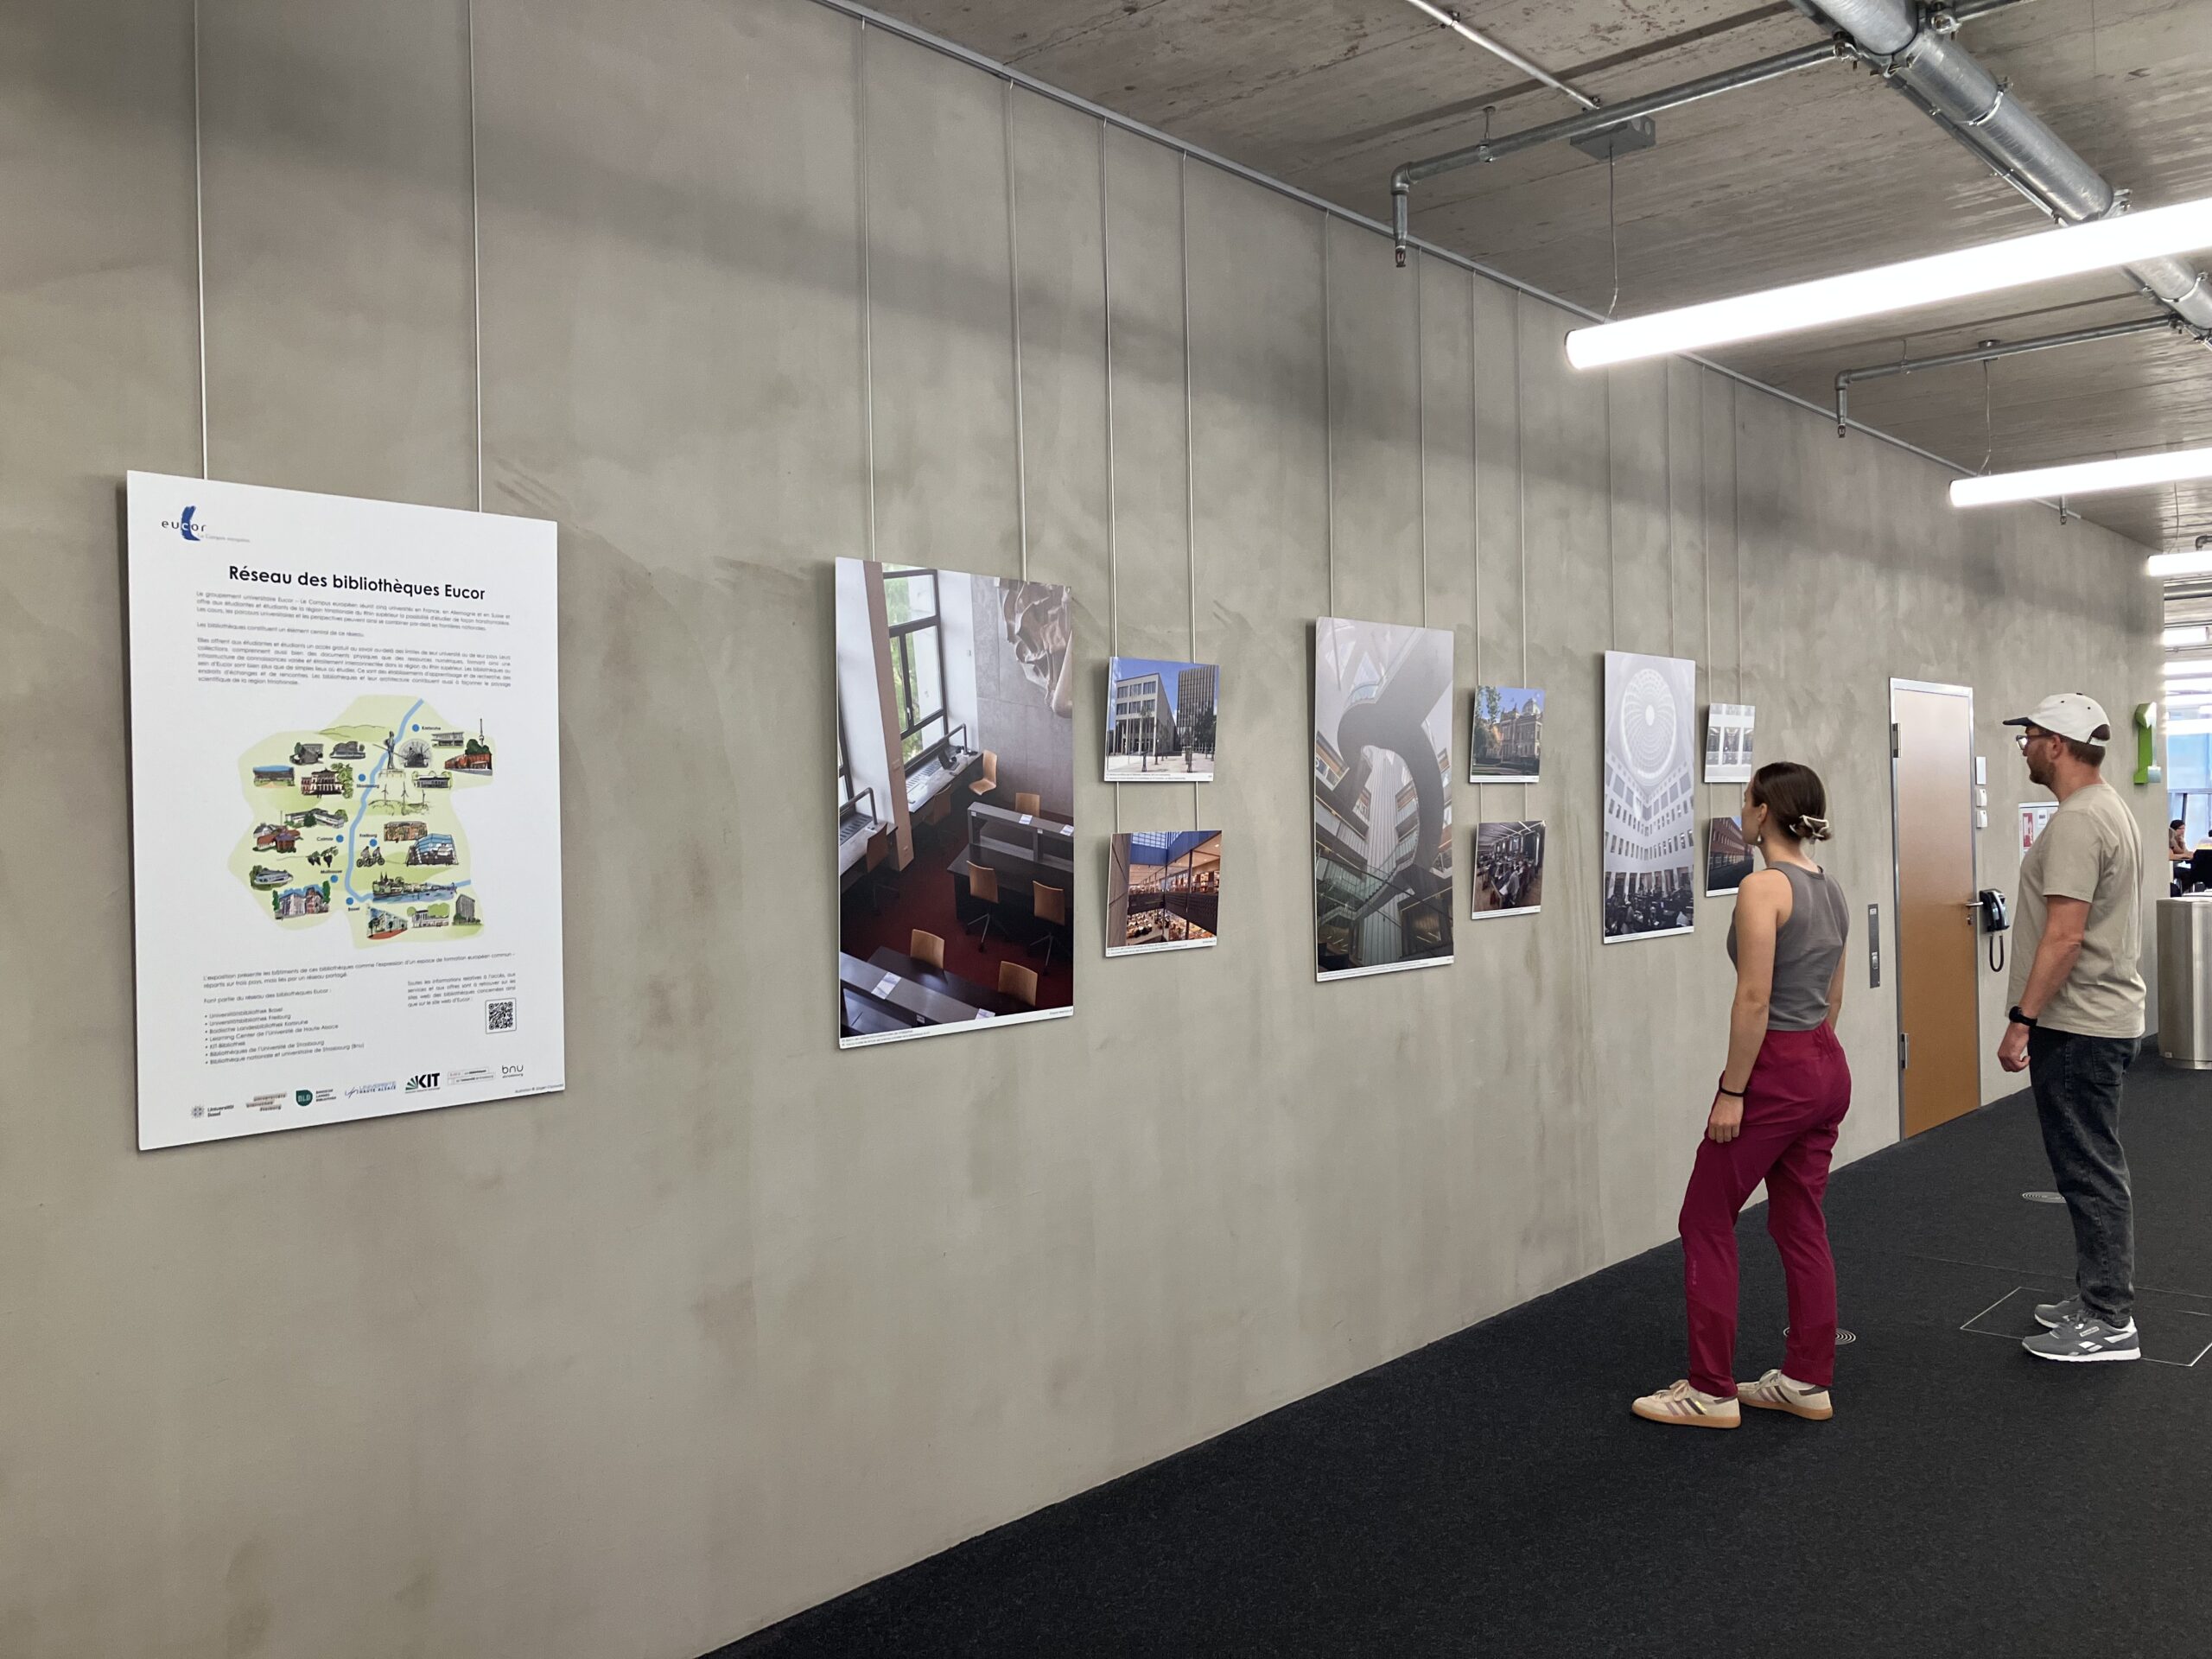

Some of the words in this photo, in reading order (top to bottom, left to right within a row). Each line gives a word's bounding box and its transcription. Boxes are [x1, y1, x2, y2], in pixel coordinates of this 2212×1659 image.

[162, 519, 207, 532] eucor
[229, 565, 291, 583] Réseau
[297, 572, 327, 587] des
[333, 575, 438, 596] bibliothèques
[444, 584, 485, 599] Eucor
[501, 1065, 523, 1074] bnu
[418, 1072, 440, 1088] KIT
